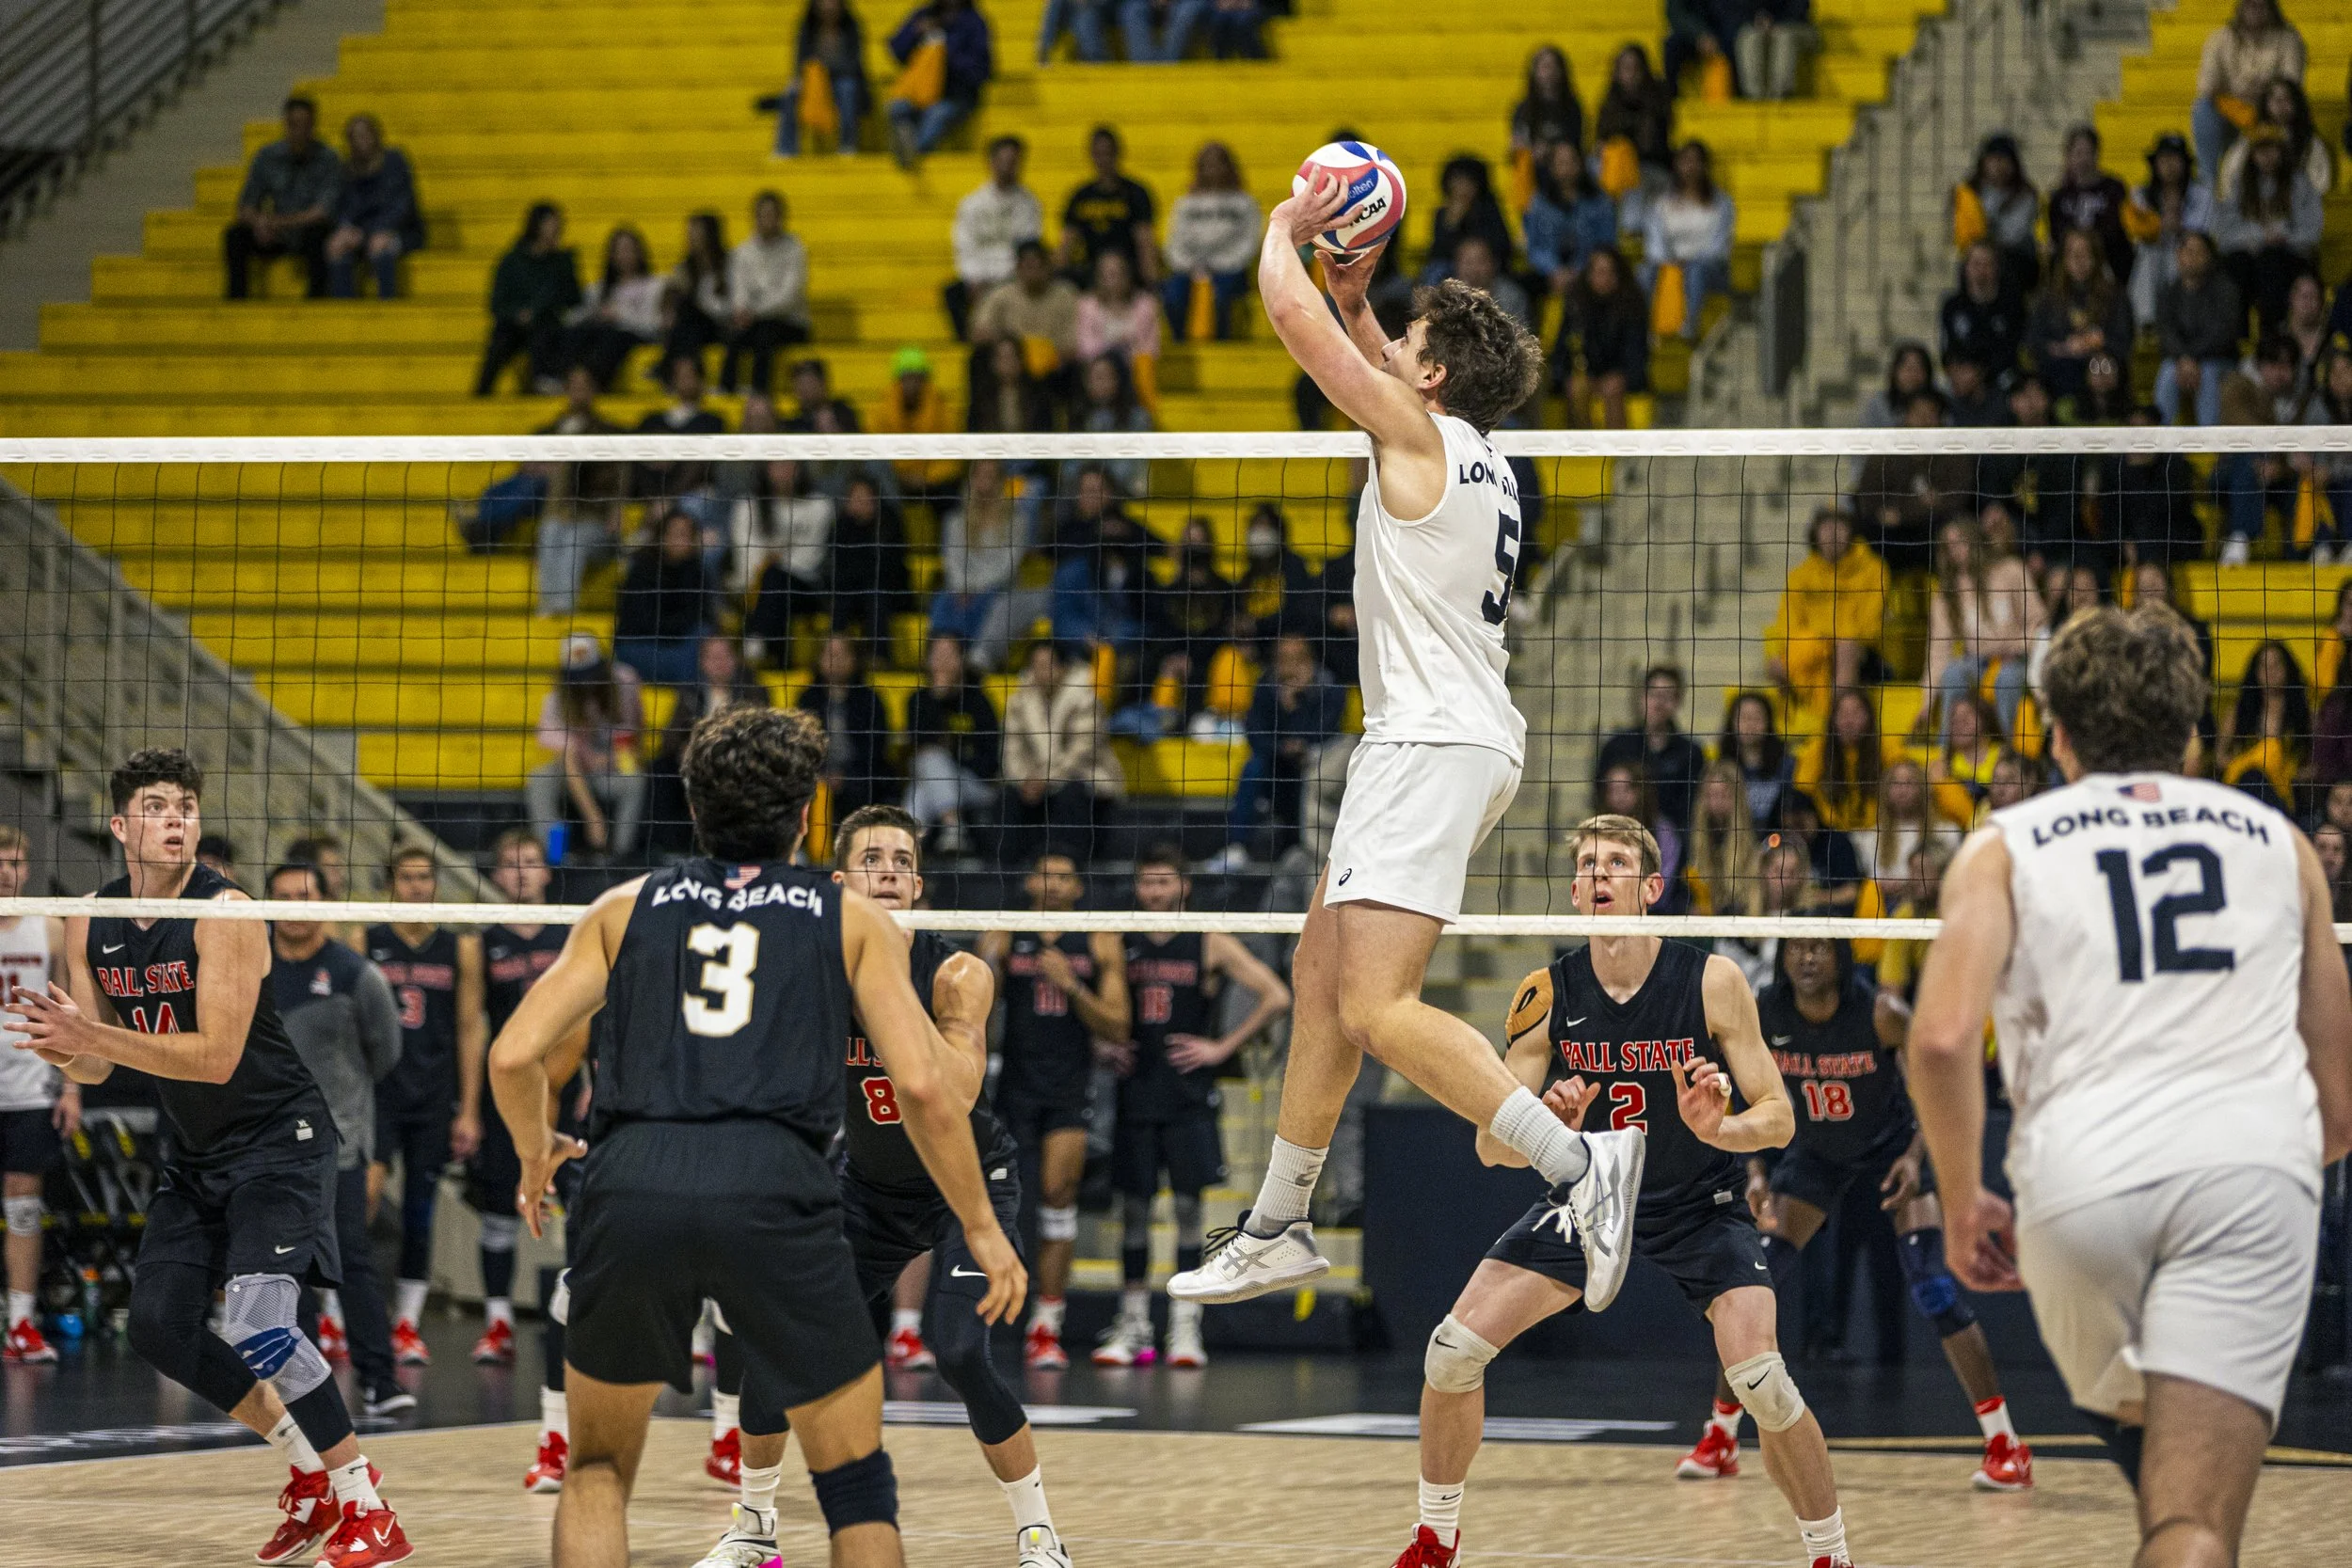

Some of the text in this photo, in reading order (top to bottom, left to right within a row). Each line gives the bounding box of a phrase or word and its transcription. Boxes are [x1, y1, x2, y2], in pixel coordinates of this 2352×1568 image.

[1347, 178, 1375, 200] olten
[1482, 509, 1518, 626] 5
[2032, 807, 2269, 846] LONG BEACH
[651, 877, 822, 917] LONG BEACH
[2094, 843, 2235, 982] 12
[682, 921, 760, 1037] 3
[860, 1076, 903, 1125] 8
[1609, 1082, 1647, 1135] 2
[1801, 1080, 1854, 1121] 18
